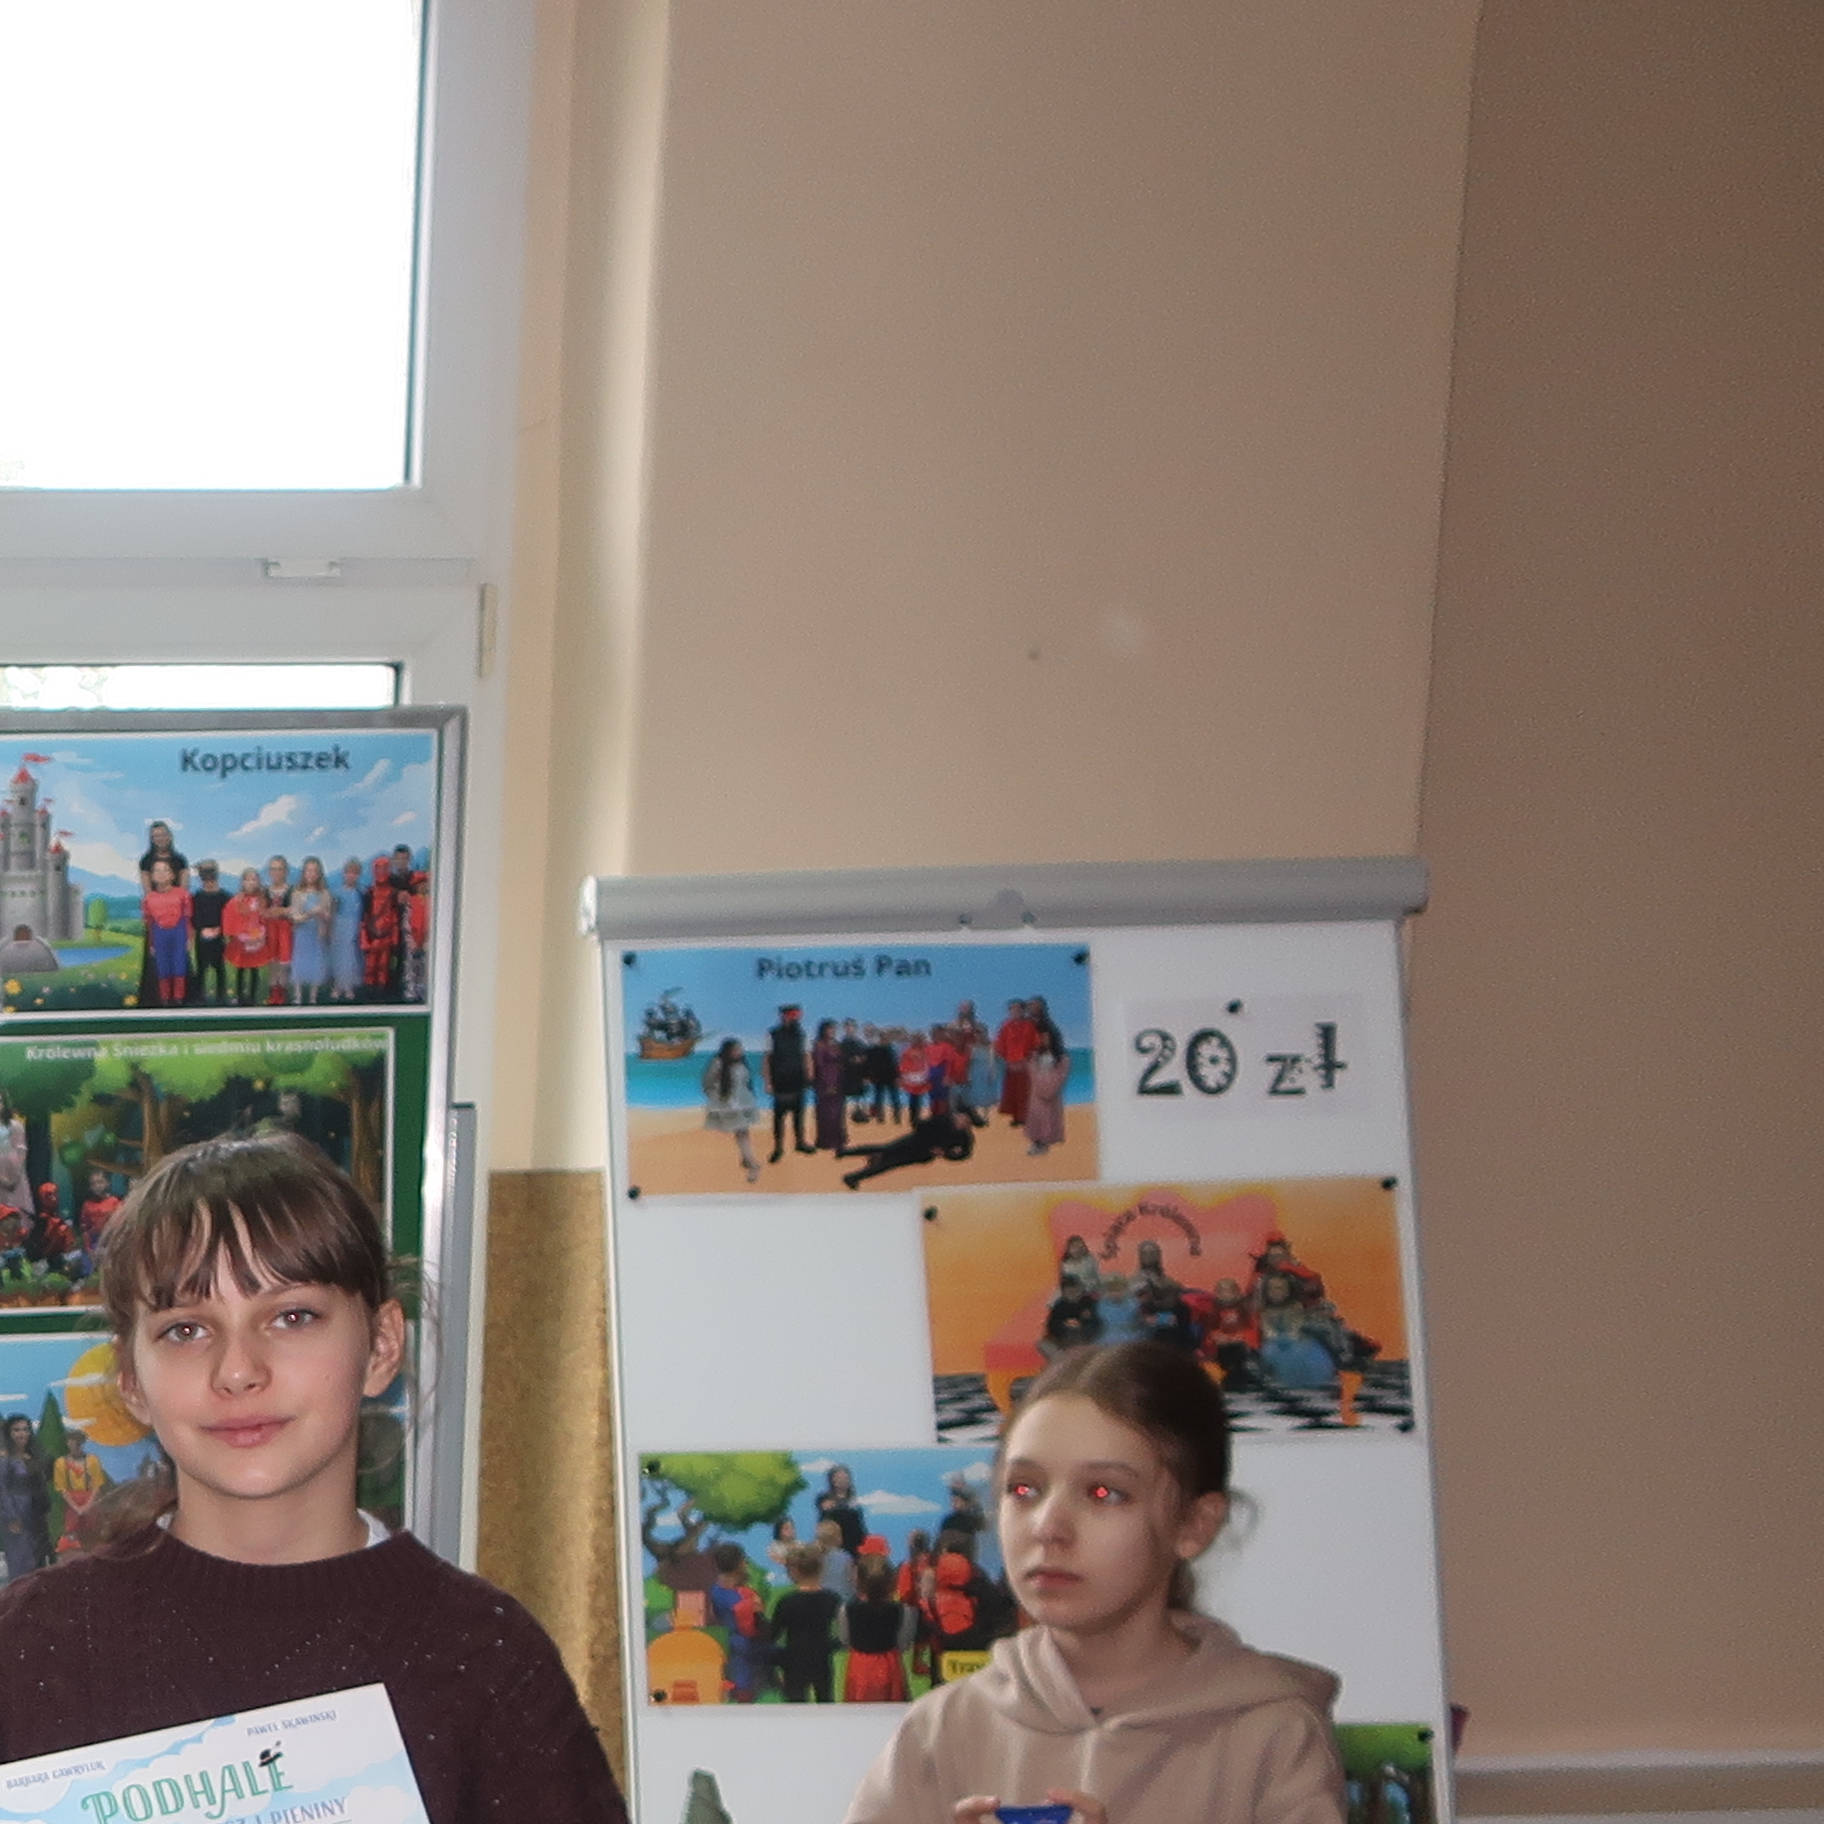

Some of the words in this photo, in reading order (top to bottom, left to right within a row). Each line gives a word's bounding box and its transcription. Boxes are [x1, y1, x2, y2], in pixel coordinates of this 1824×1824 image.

[180, 745, 351, 778] Kopciuszek
[755, 953, 868, 981] Piotruś
[876, 954, 933, 979] Pan
[1133, 1027, 1238, 1098] 20
[1265, 1022, 1347, 1098] zł
